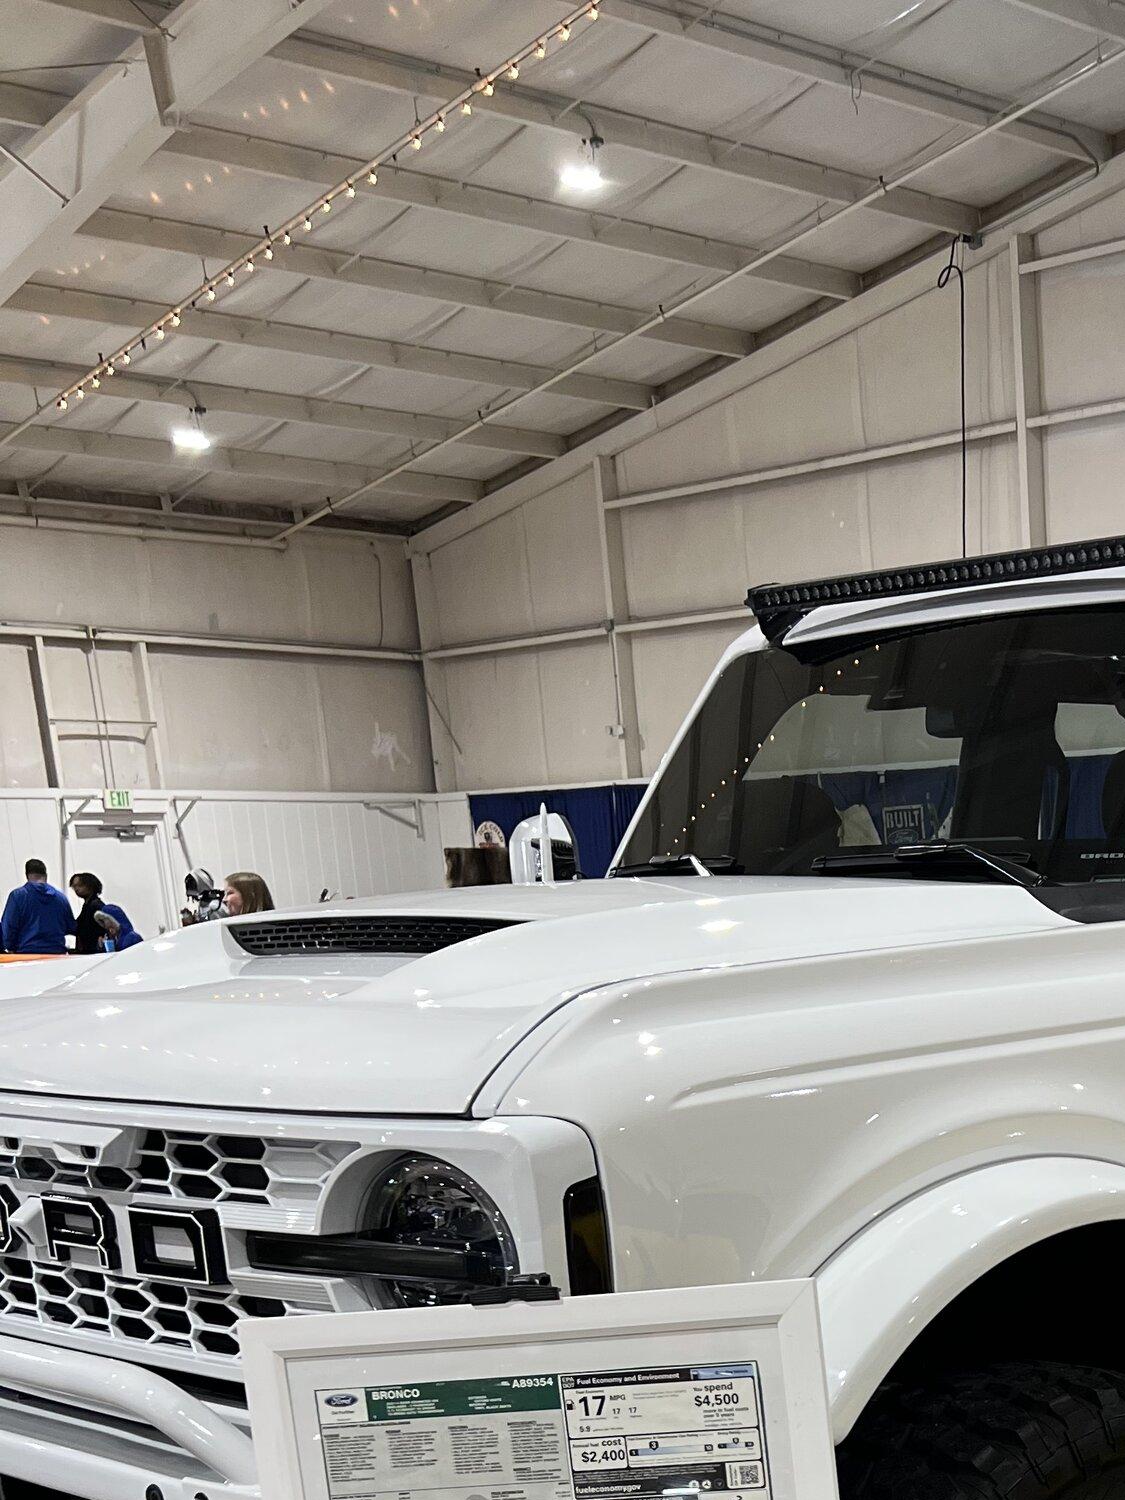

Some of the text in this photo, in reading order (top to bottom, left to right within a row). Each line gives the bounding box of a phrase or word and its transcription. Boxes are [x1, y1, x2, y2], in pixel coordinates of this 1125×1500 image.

[110, 791, 129, 807] EXIT
[886, 810, 920, 829] BUILT
[512, 1377, 554, 1389] A89354
[592, 1376, 622, 1384] Economy
[638, 1373, 680, 1381] Environment
[704, 1382, 733, 1393] spend
[371, 1388, 420, 1401] BRONCO
[694, 1393, 739, 1407] $4,500
[579, 1395, 606, 1417] 17
[601, 1437, 622, 1447] cost
[581, 1450, 626, 1464] $2,400
